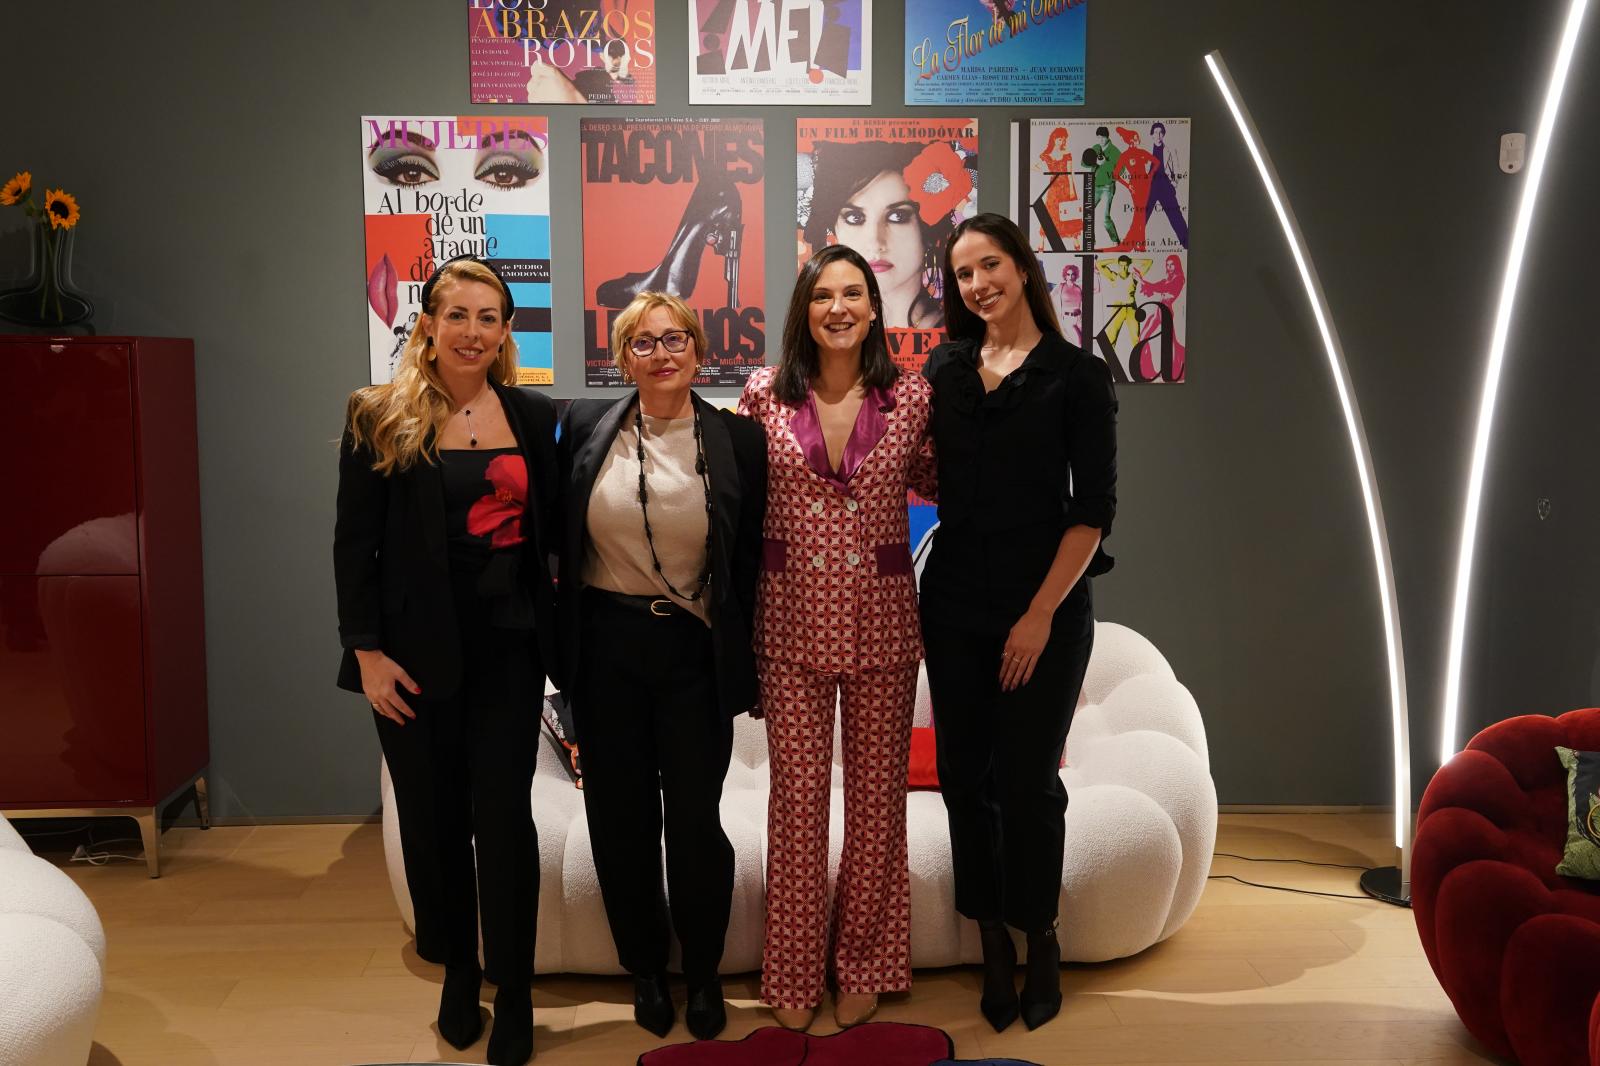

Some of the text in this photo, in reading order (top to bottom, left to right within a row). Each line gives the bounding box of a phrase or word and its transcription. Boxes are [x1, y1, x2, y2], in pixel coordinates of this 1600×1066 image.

[473, 8, 653, 40] ABRAZOS
[520, 37, 654, 69] ROTOS
[912, 37, 941, 81] La
[943, 16, 985, 71] Flor
[989, 8, 1006, 48] de
[364, 119, 548, 151] MUJERES
[799, 124, 975, 139] UN FILM DE ALMODÓVAR
[581, 130, 765, 184] TACONES
[378, 187, 483, 215] Al borde
[425, 212, 487, 238] de un
[423, 236, 498, 262] ataque
